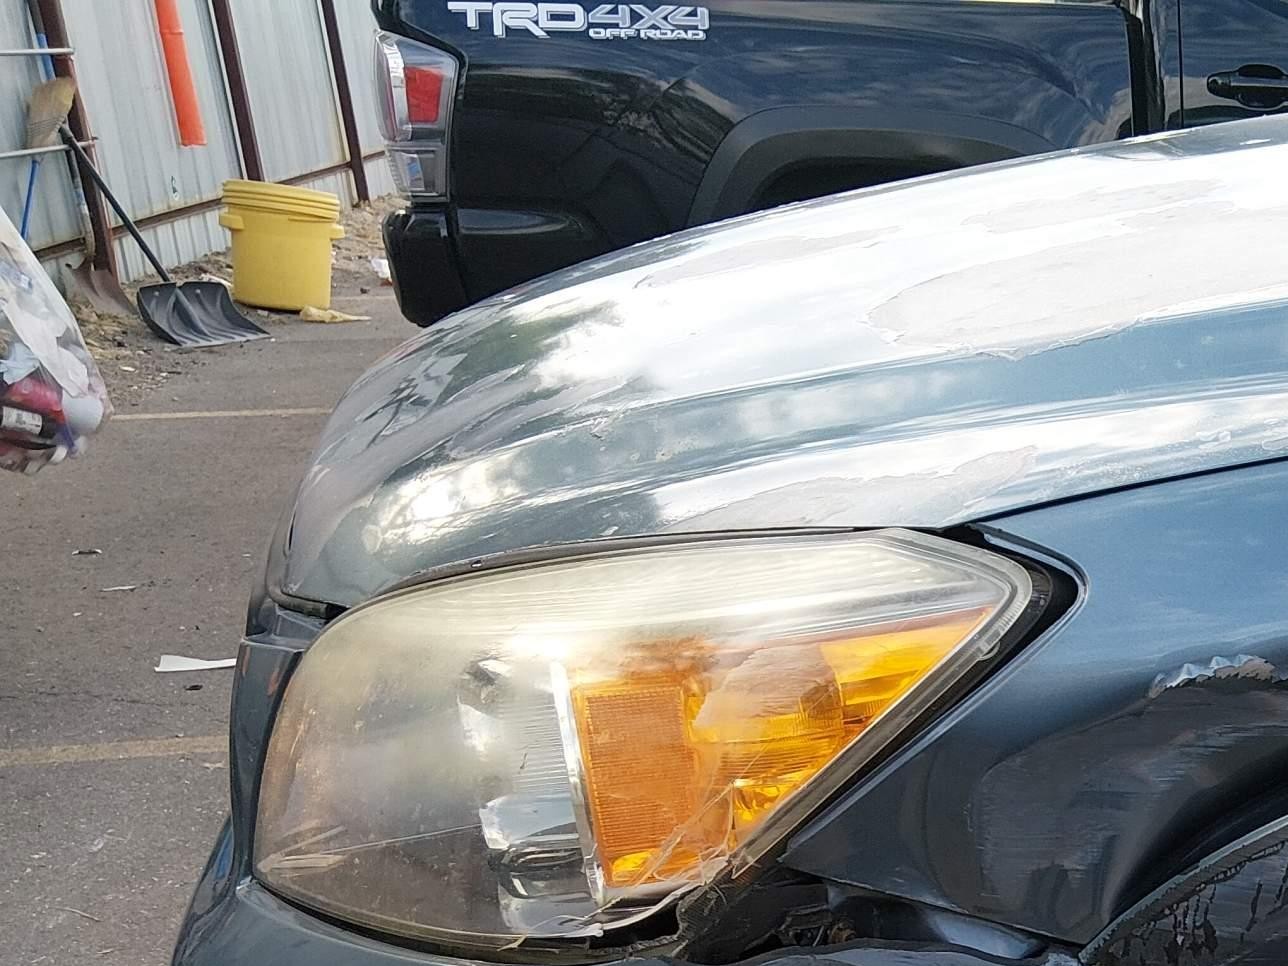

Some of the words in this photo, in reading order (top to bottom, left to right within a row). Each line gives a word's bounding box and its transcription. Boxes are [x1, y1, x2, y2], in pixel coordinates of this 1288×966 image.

[447, 1, 587, 38] TRD
[588, 28, 637, 40] OFF
[639, 28, 706, 40] ROAD
